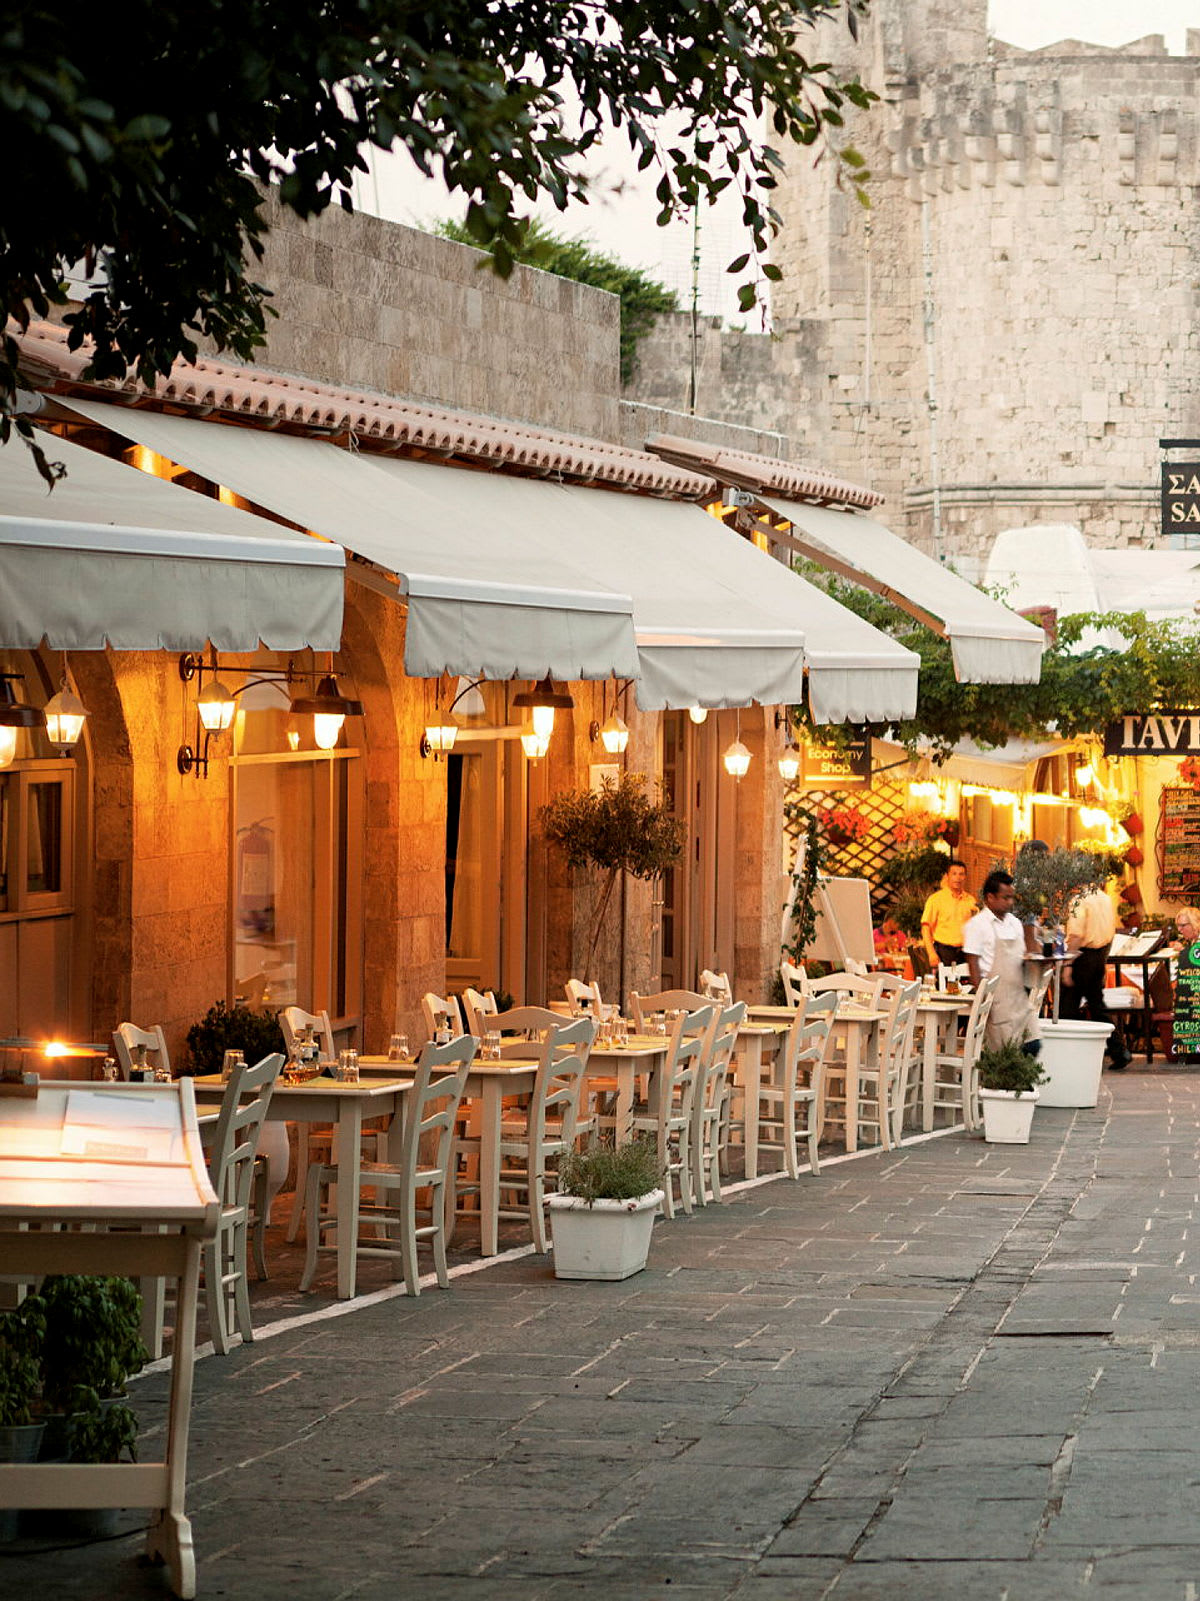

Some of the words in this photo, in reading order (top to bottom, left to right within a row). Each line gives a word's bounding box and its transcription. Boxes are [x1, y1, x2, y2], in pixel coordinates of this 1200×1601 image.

[808, 747, 863, 760] Economy
[820, 761, 851, 774] Shop
[1173, 1021, 1199, 1031] GYROS
